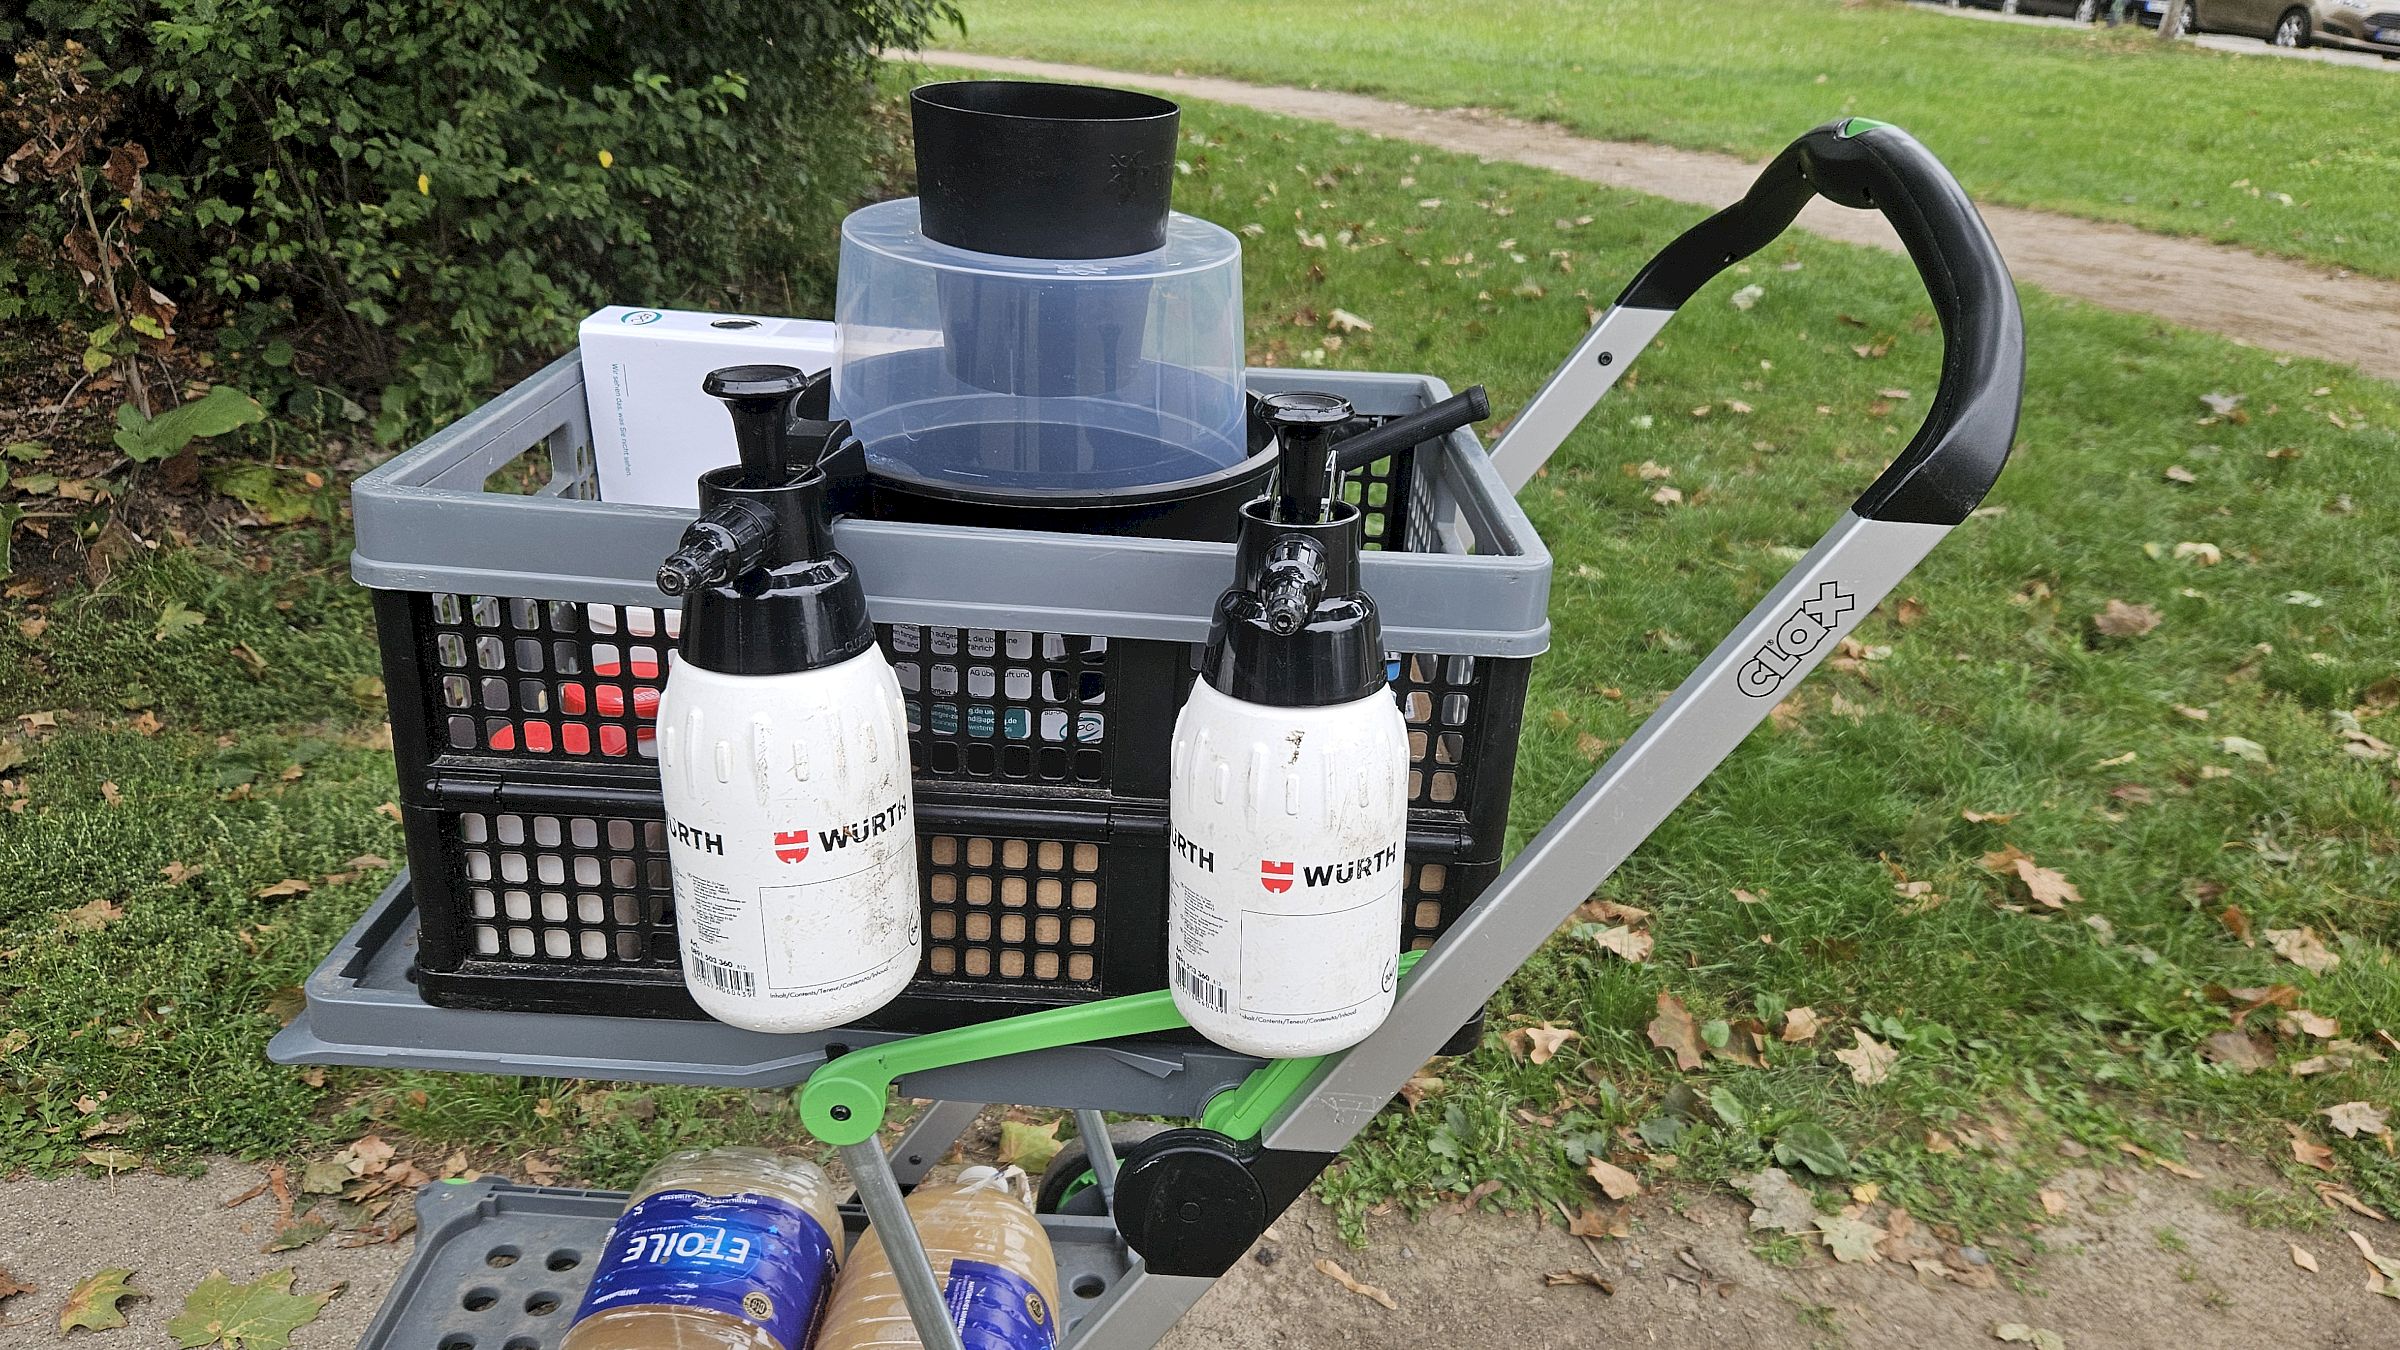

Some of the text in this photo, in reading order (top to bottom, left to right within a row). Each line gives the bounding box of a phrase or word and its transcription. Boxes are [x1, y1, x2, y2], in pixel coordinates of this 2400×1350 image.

[665, 810, 724, 855] ÜRTH
[819, 796, 907, 852] WÜRTH
[1171, 826, 1214, 873] ÜRTH
[1303, 842, 1397, 887] WÜRTH
